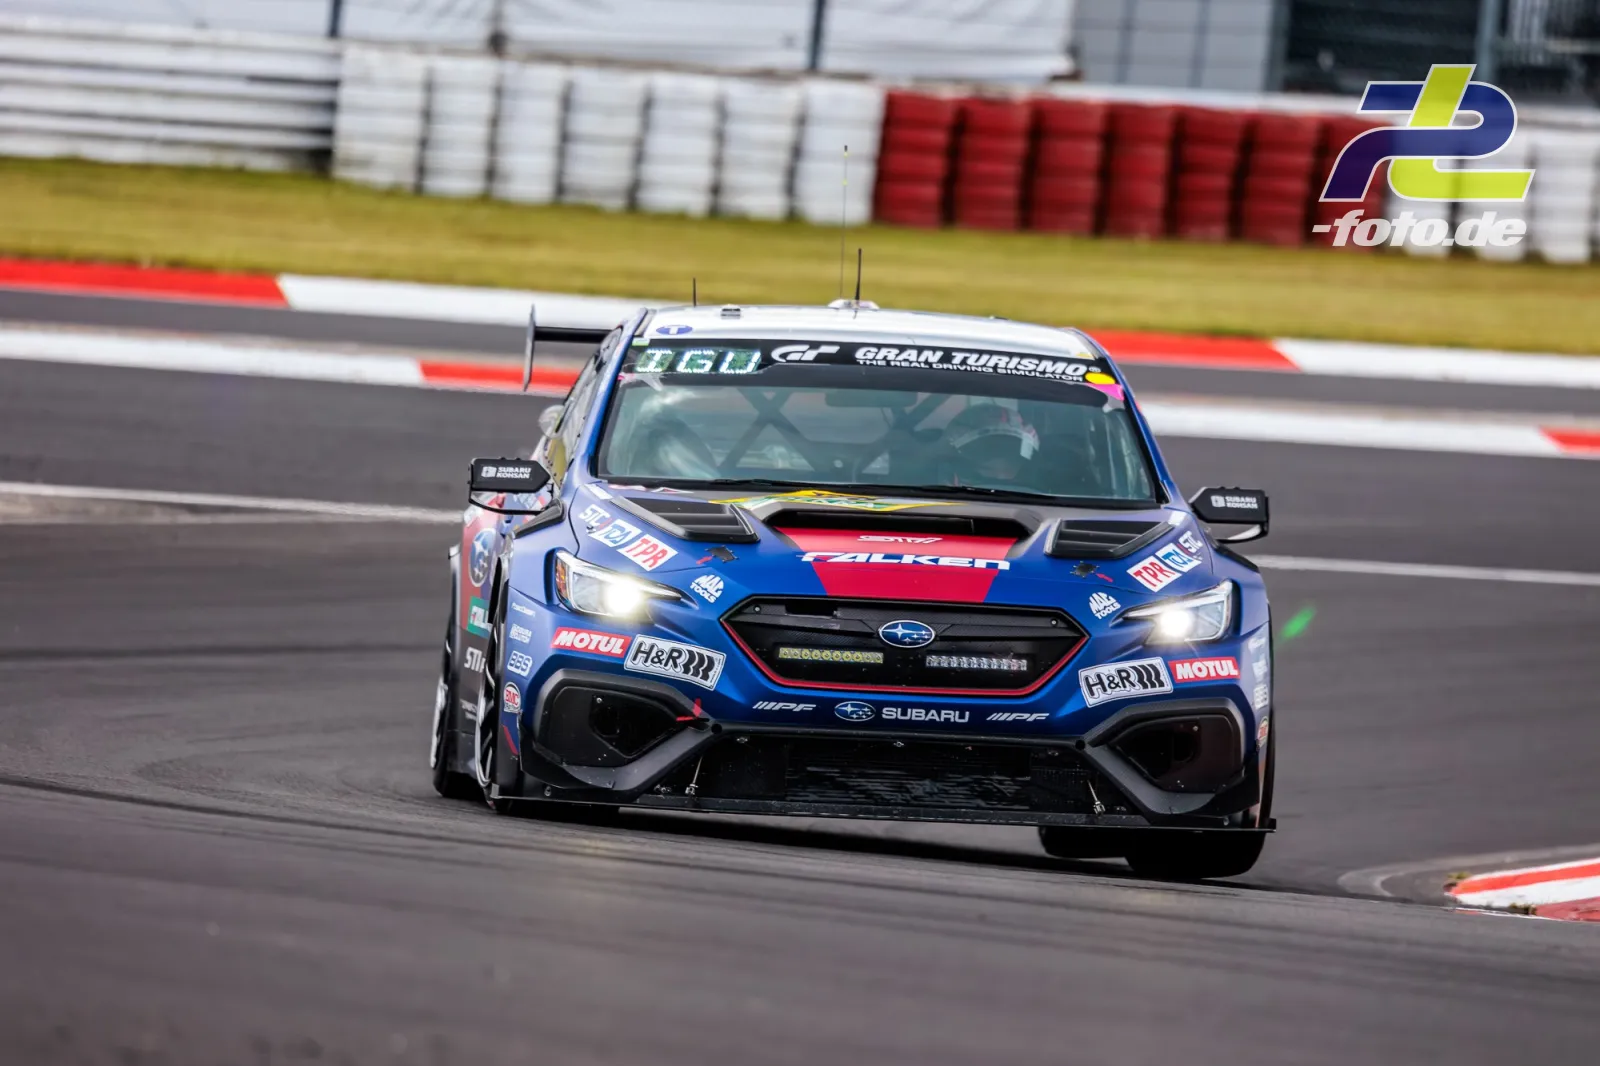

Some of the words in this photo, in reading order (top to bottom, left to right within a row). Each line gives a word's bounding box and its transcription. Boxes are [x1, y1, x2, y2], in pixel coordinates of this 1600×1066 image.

[854, 346, 944, 364] GRAN
[890, 360, 929, 368] REAL
[932, 362, 994, 374] DRIVING
[997, 366, 1083, 382] SIMULATOR
[625, 537, 669, 569] TPR
[800, 551, 1011, 571] FALKEN
[1132, 560, 1176, 588] TPR
[689, 582, 718, 604] TOOLS
[693, 574, 725, 598] MAC
[1088, 591, 1118, 614] MAC
[1094, 602, 1122, 620] TOOLS
[553, 630, 626, 655] MOTUL
[507, 651, 532, 676] BBS
[631, 640, 685, 673] H&R
[1175, 659, 1239, 680] MOTUL
[1083, 668, 1139, 699] H&R
[881, 707, 970, 723] SUBARU
